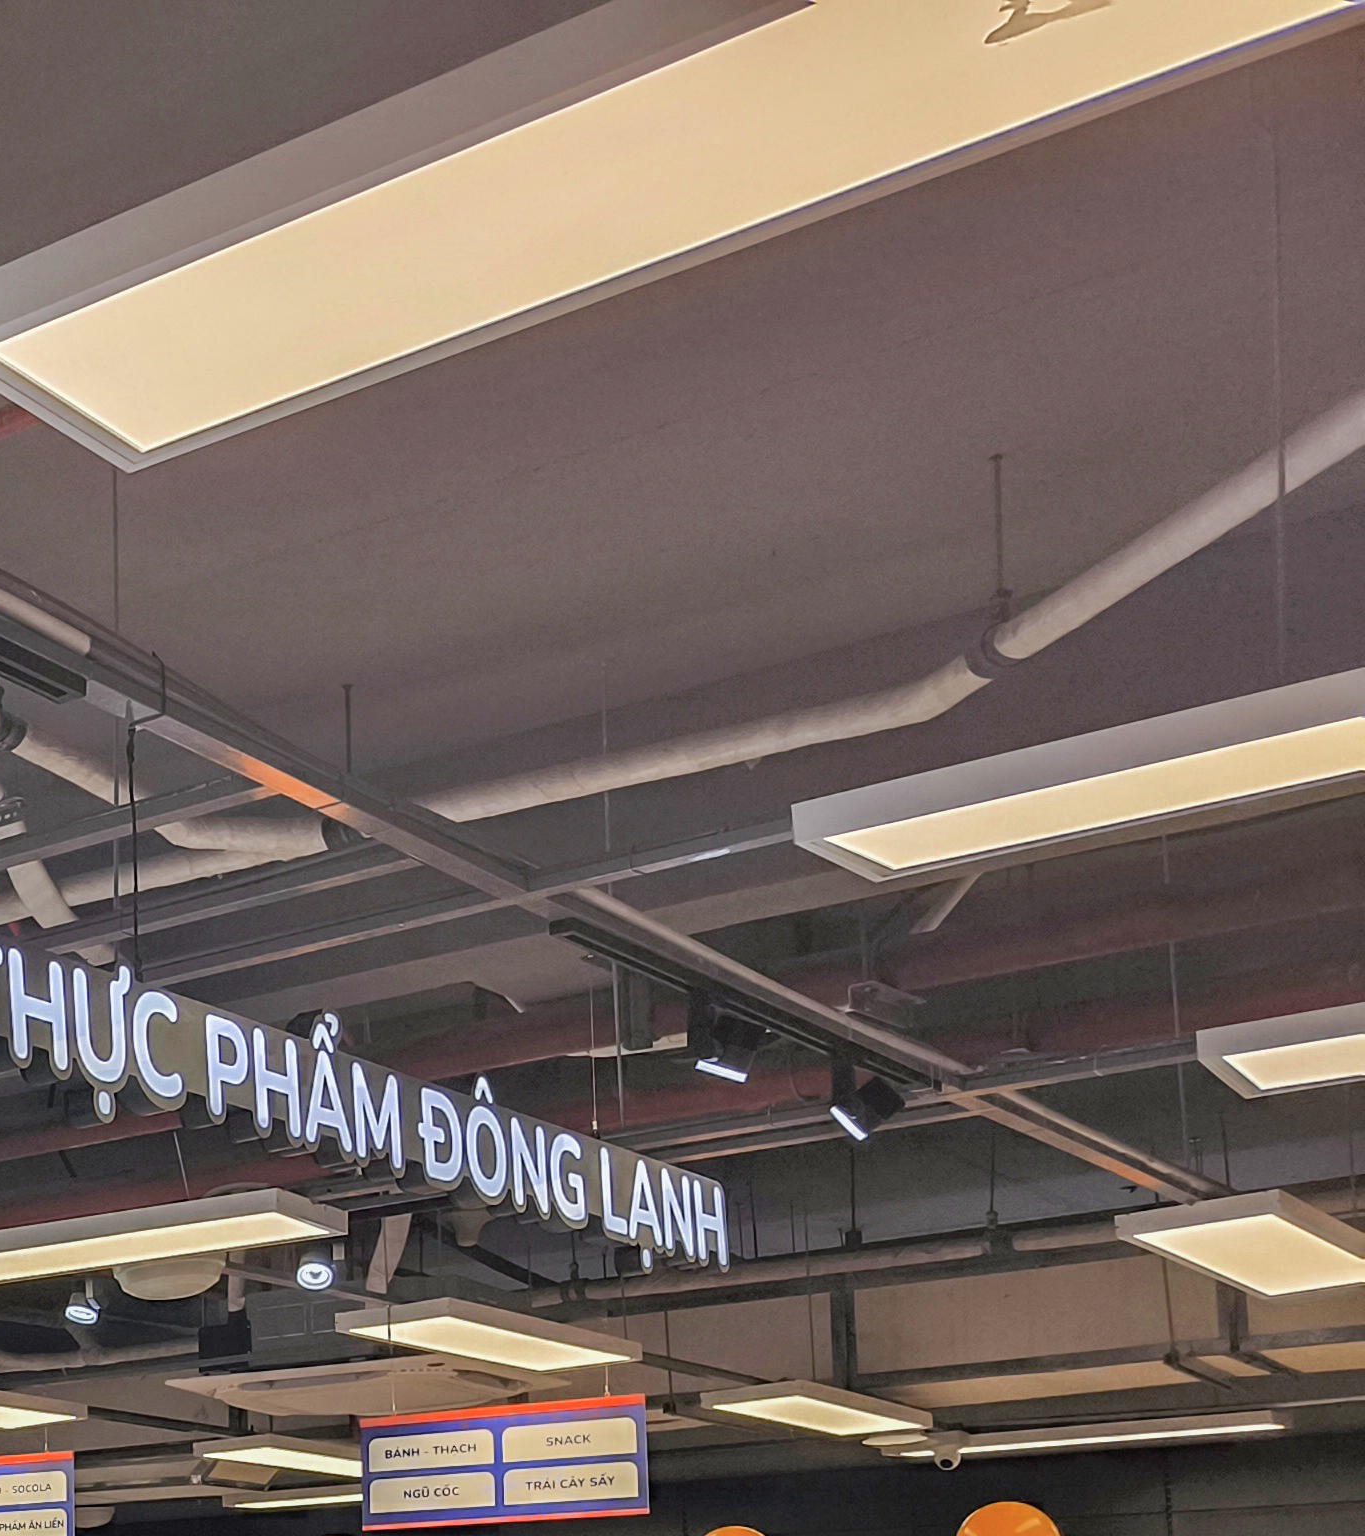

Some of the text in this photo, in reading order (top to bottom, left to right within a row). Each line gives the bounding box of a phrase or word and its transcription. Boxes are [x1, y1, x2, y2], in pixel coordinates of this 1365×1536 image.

[205, 1013, 405, 1170] PHẨM
[417, 1073, 589, 1224] ĐÔNG
[600, 1146, 730, 1271] LẠNH
[547, 1434, 591, 1446] SNACK
[385, 1448, 419, 1458] BÁNH
[525, 1473, 615, 1490] TRÁI CÂY SẤY
[12, 1484, 51, 1494] SOCOLA
[403, 1484, 459, 1498] NGŨ CỐC
